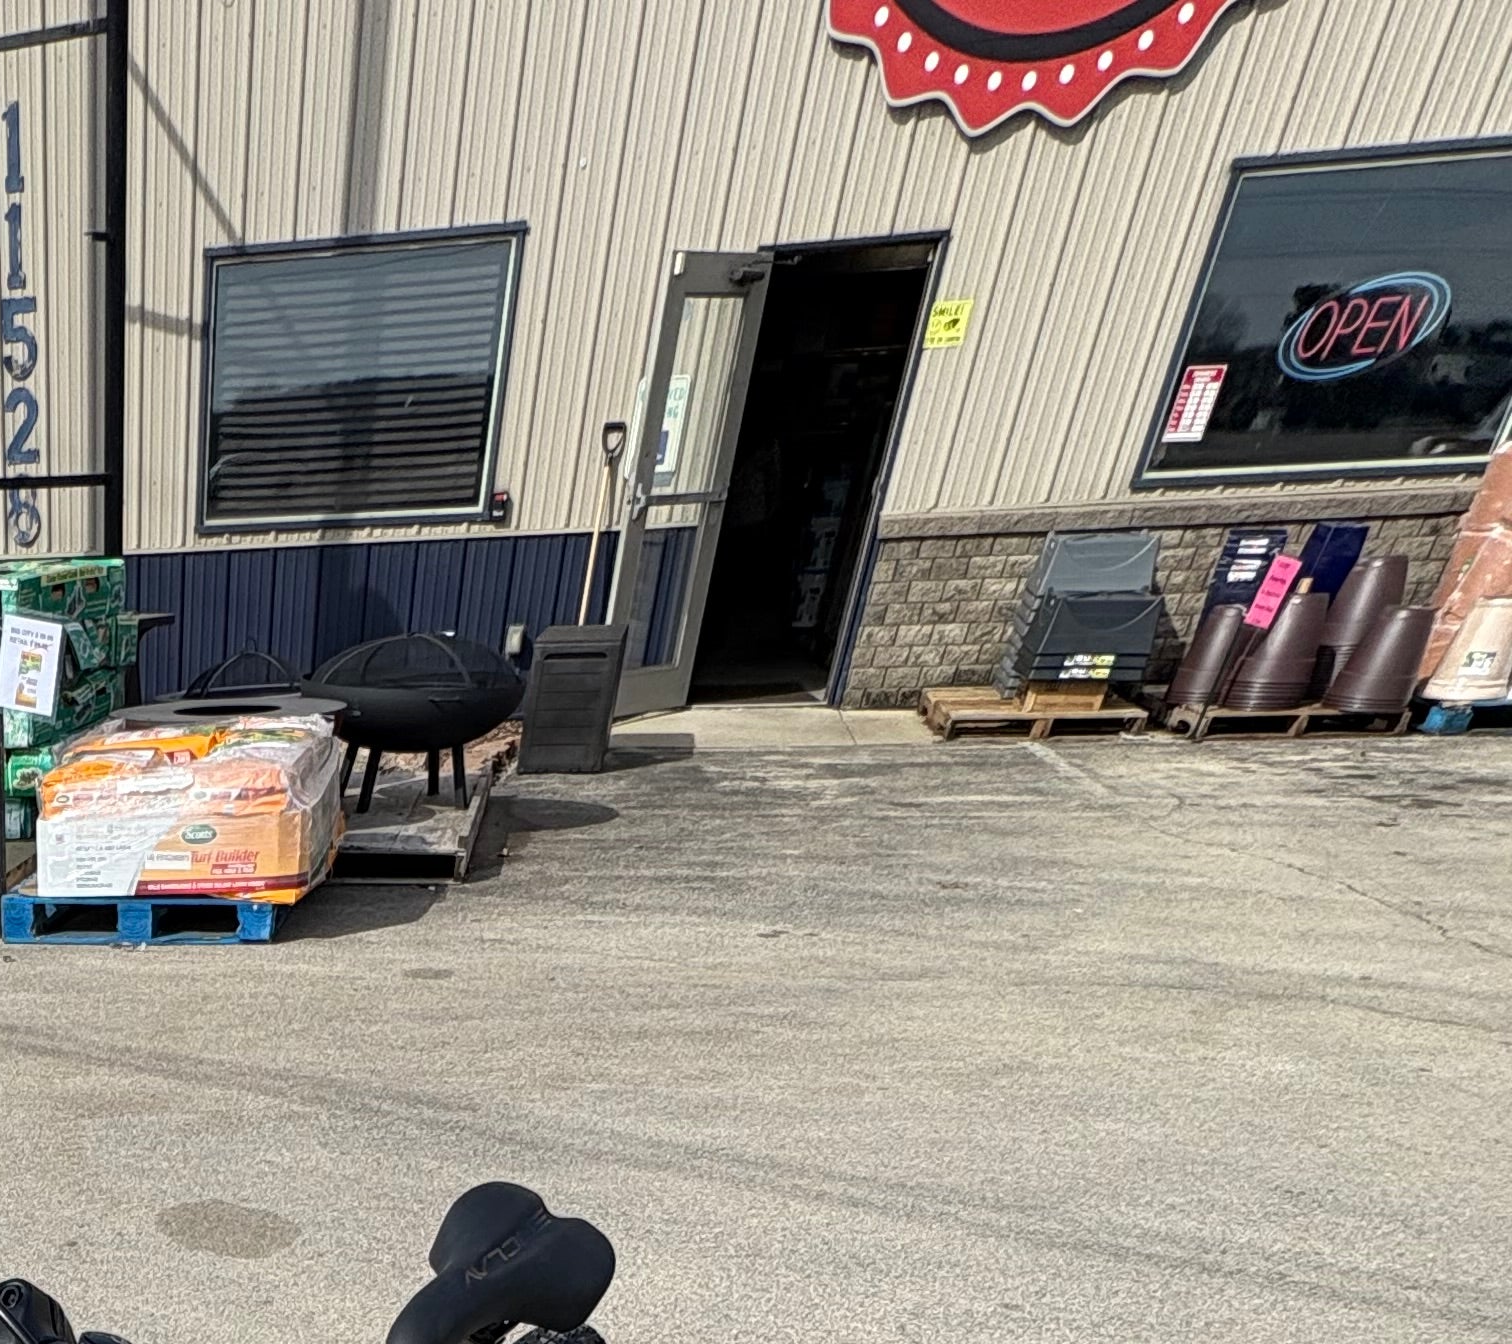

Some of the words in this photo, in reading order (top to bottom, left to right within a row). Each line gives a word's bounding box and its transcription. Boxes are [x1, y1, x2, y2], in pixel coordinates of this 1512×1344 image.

[1298, 294, 1431, 361] OPEN
[183, 825, 214, 841] Scotts
[190, 850, 213, 865] Turf
[215, 848, 261, 863] Builder
